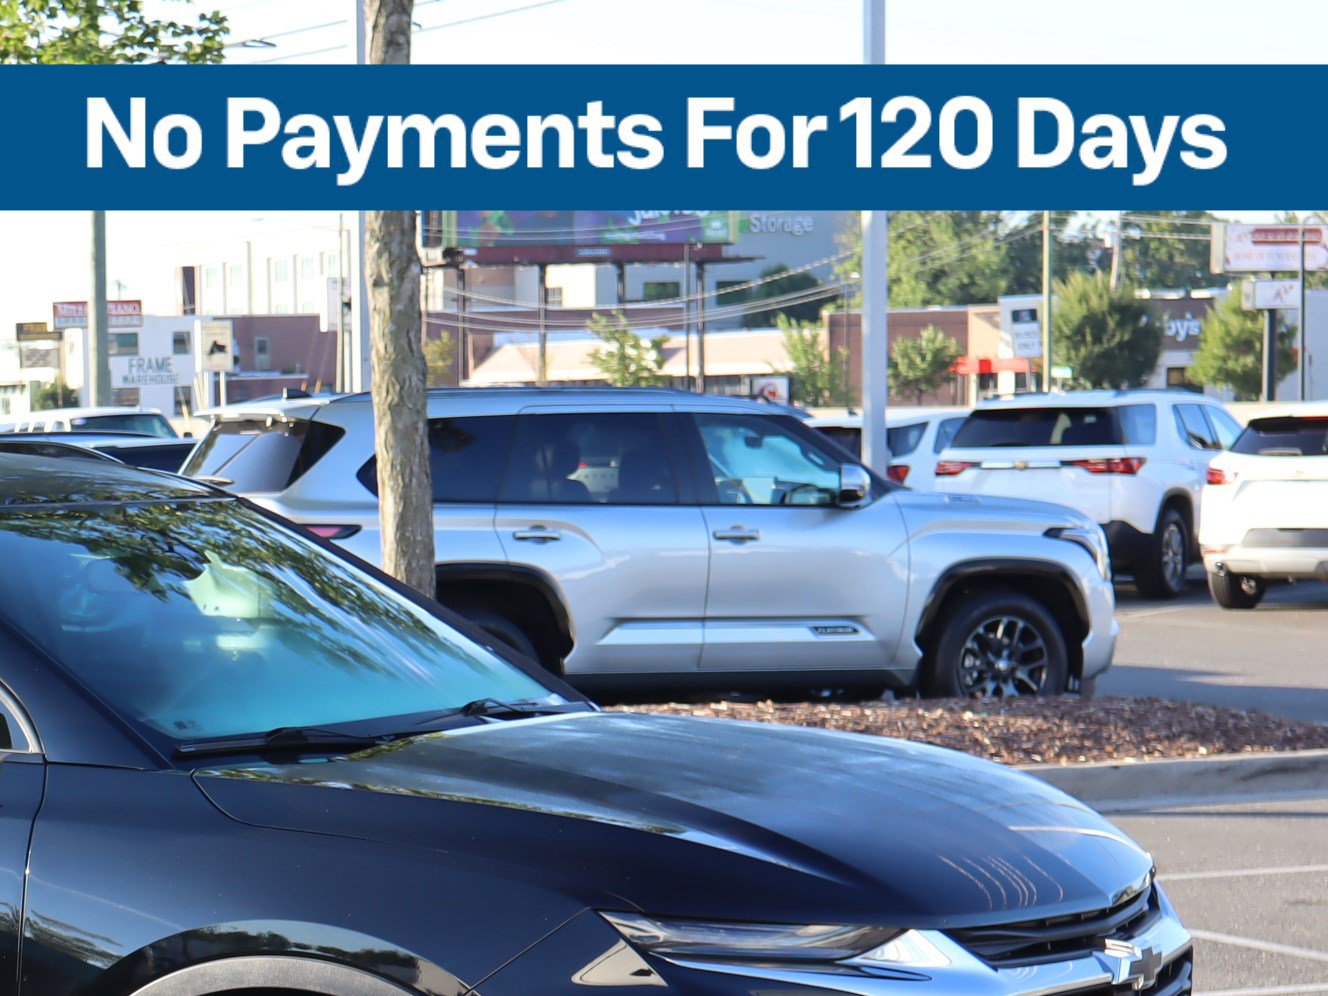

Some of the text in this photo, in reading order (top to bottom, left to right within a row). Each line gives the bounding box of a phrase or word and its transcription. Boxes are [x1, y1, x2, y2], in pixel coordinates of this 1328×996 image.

[749, 213, 815, 236] Storage
[128, 357, 173, 374] FRAME
[122, 374, 178, 385] WAREHOUSE
